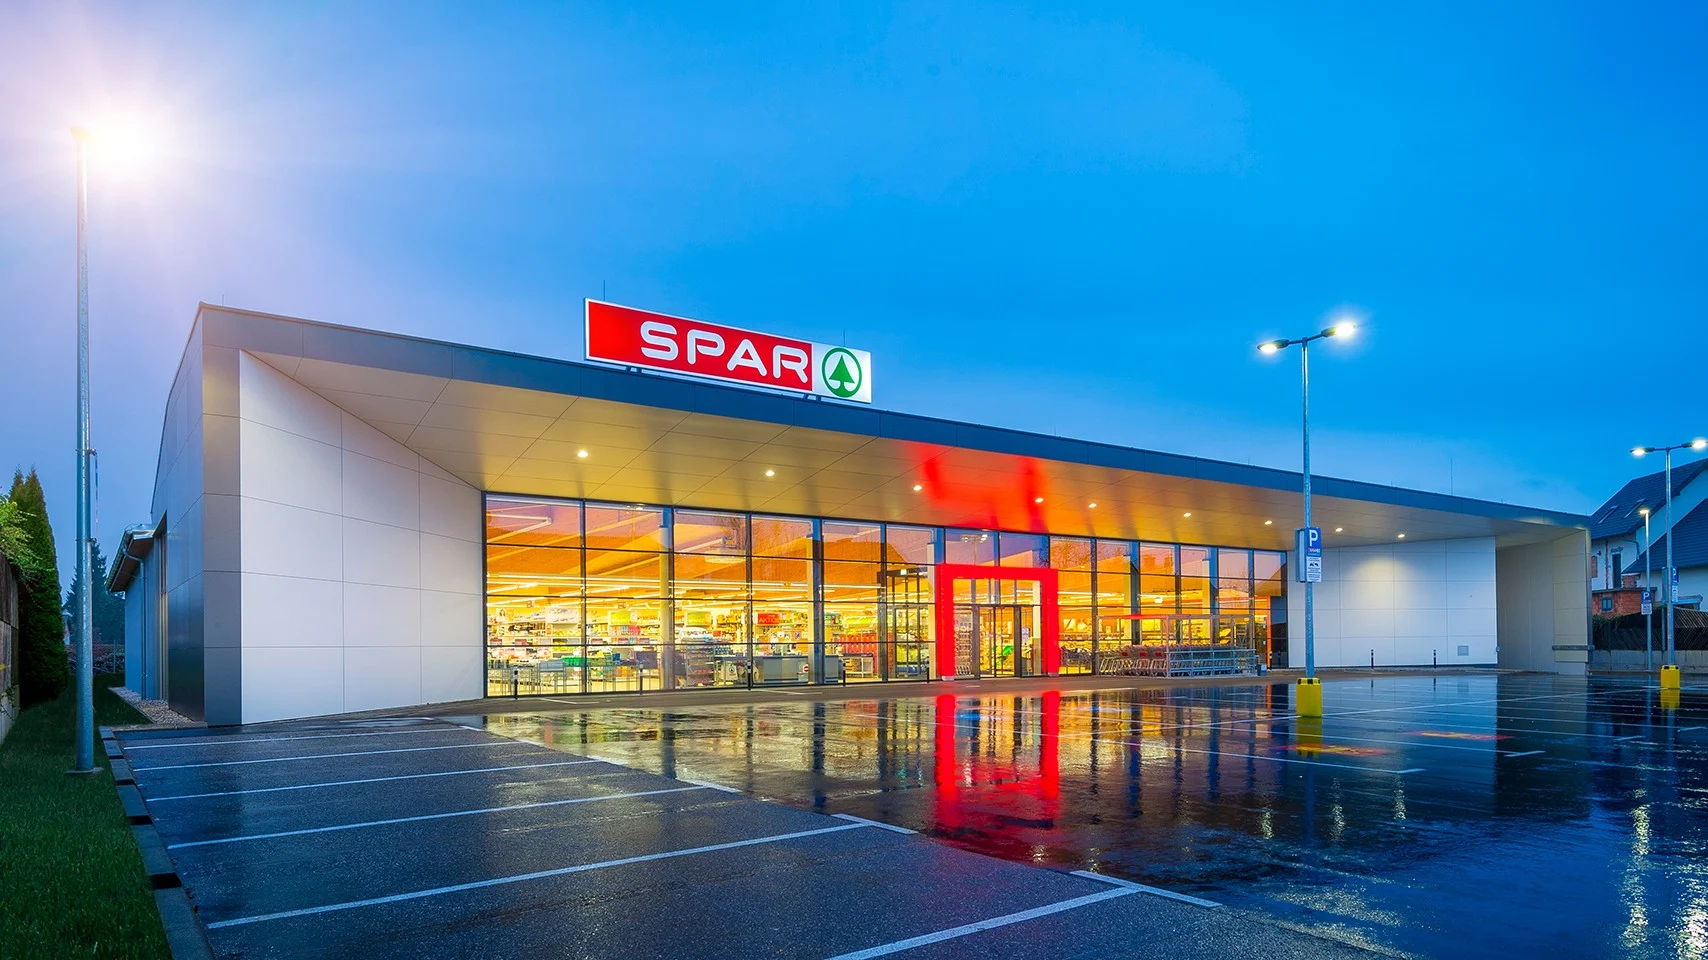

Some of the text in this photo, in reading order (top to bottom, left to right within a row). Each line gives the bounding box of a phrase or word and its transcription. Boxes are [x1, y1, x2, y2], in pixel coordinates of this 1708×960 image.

[640, 320, 808, 383] SPAR
[1309, 529, 1318, 547] P
[1643, 592, 1650, 600] P
